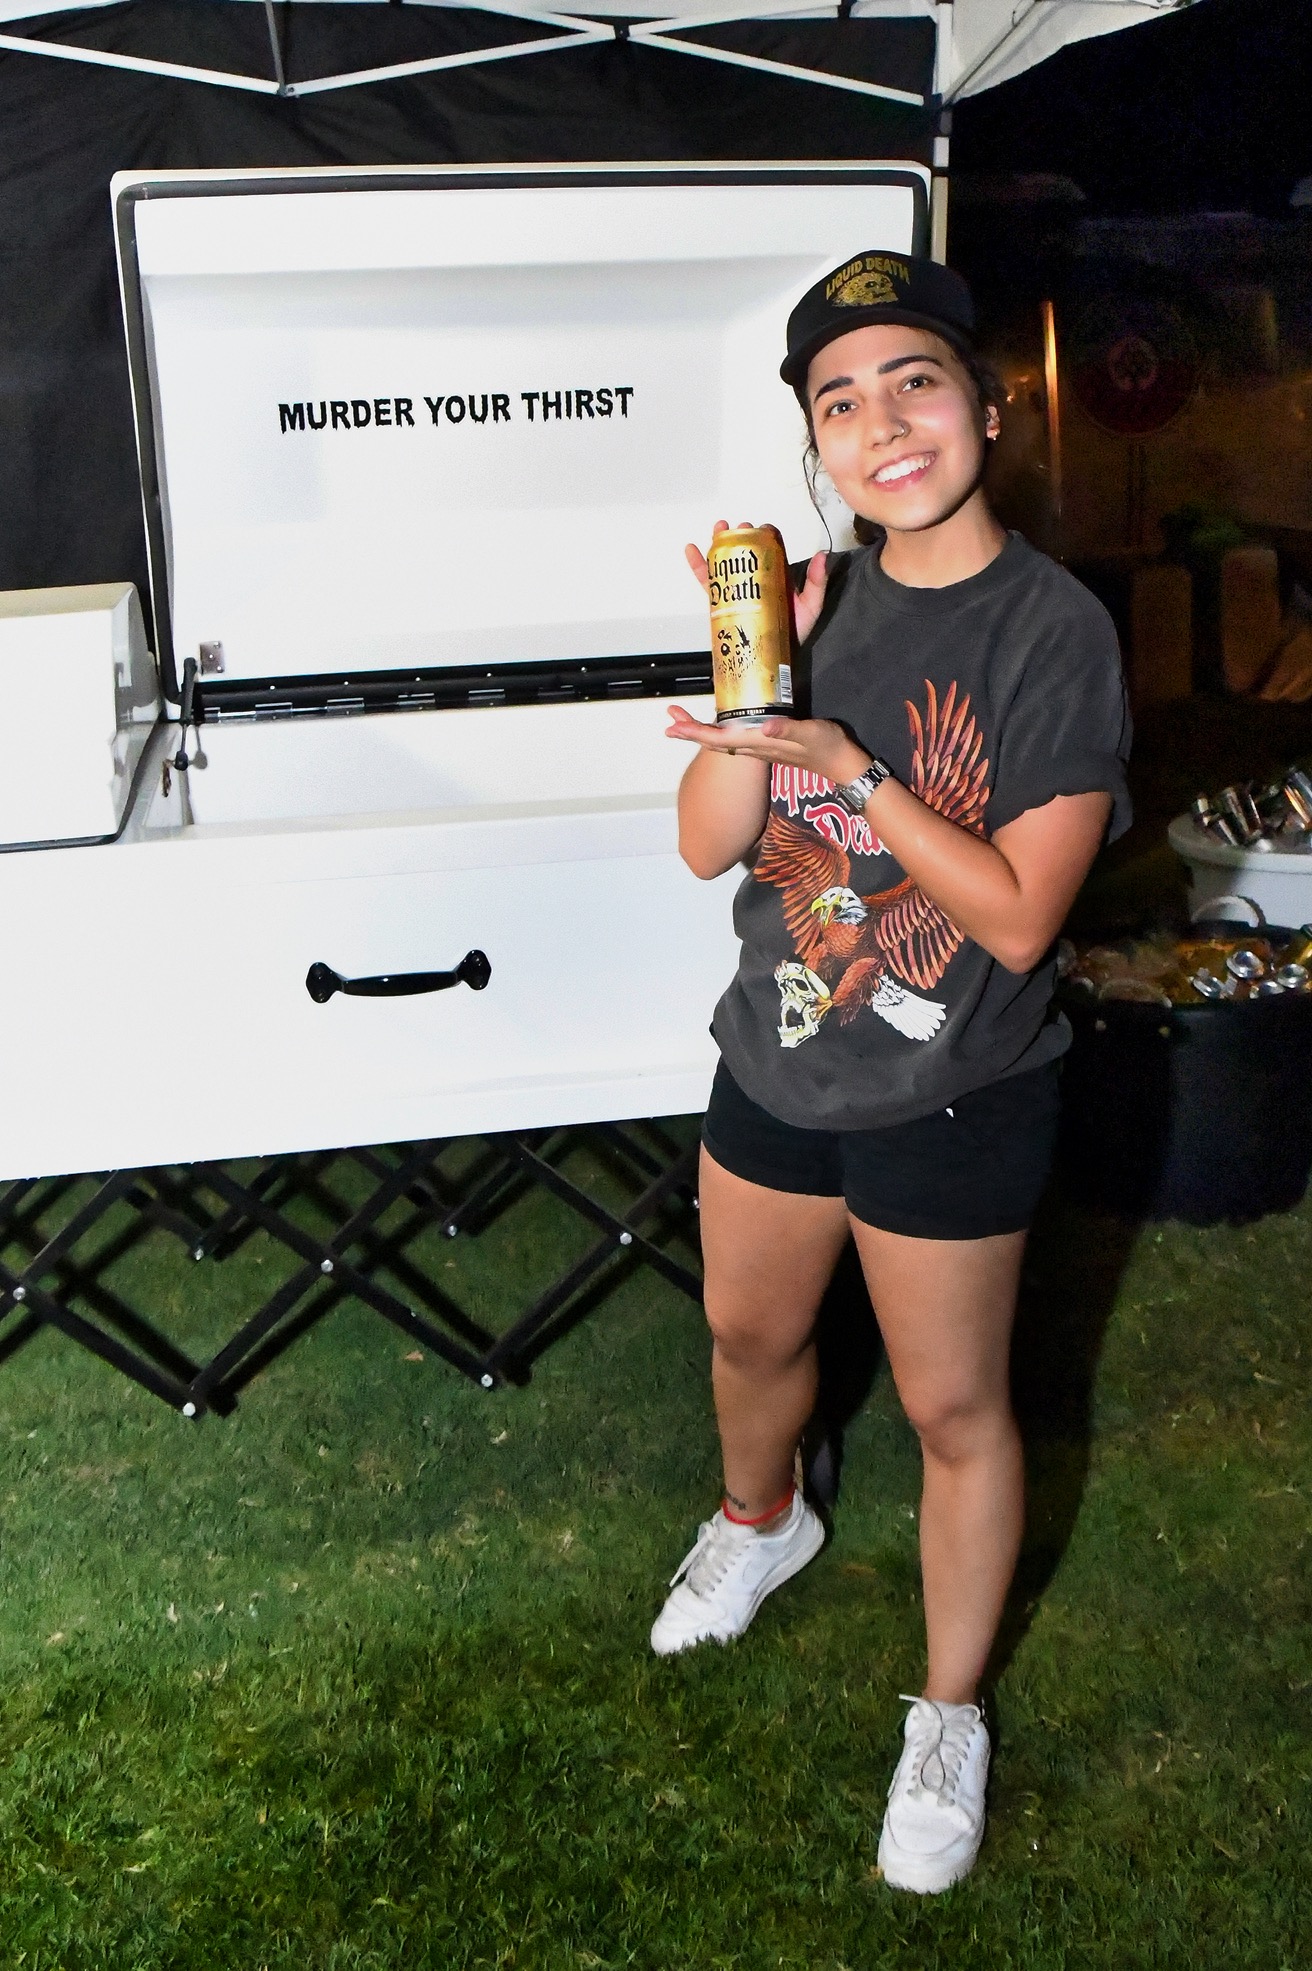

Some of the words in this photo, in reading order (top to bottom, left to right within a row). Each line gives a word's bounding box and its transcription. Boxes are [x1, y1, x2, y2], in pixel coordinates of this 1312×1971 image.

[826, 260, 863, 300] LIQUID
[865, 257, 910, 285] DEATH
[278, 398, 415, 434] MURDER
[423, 394, 511, 426] YOUR
[521, 386, 634, 422] THIRST
[709, 576, 761, 606] Death
